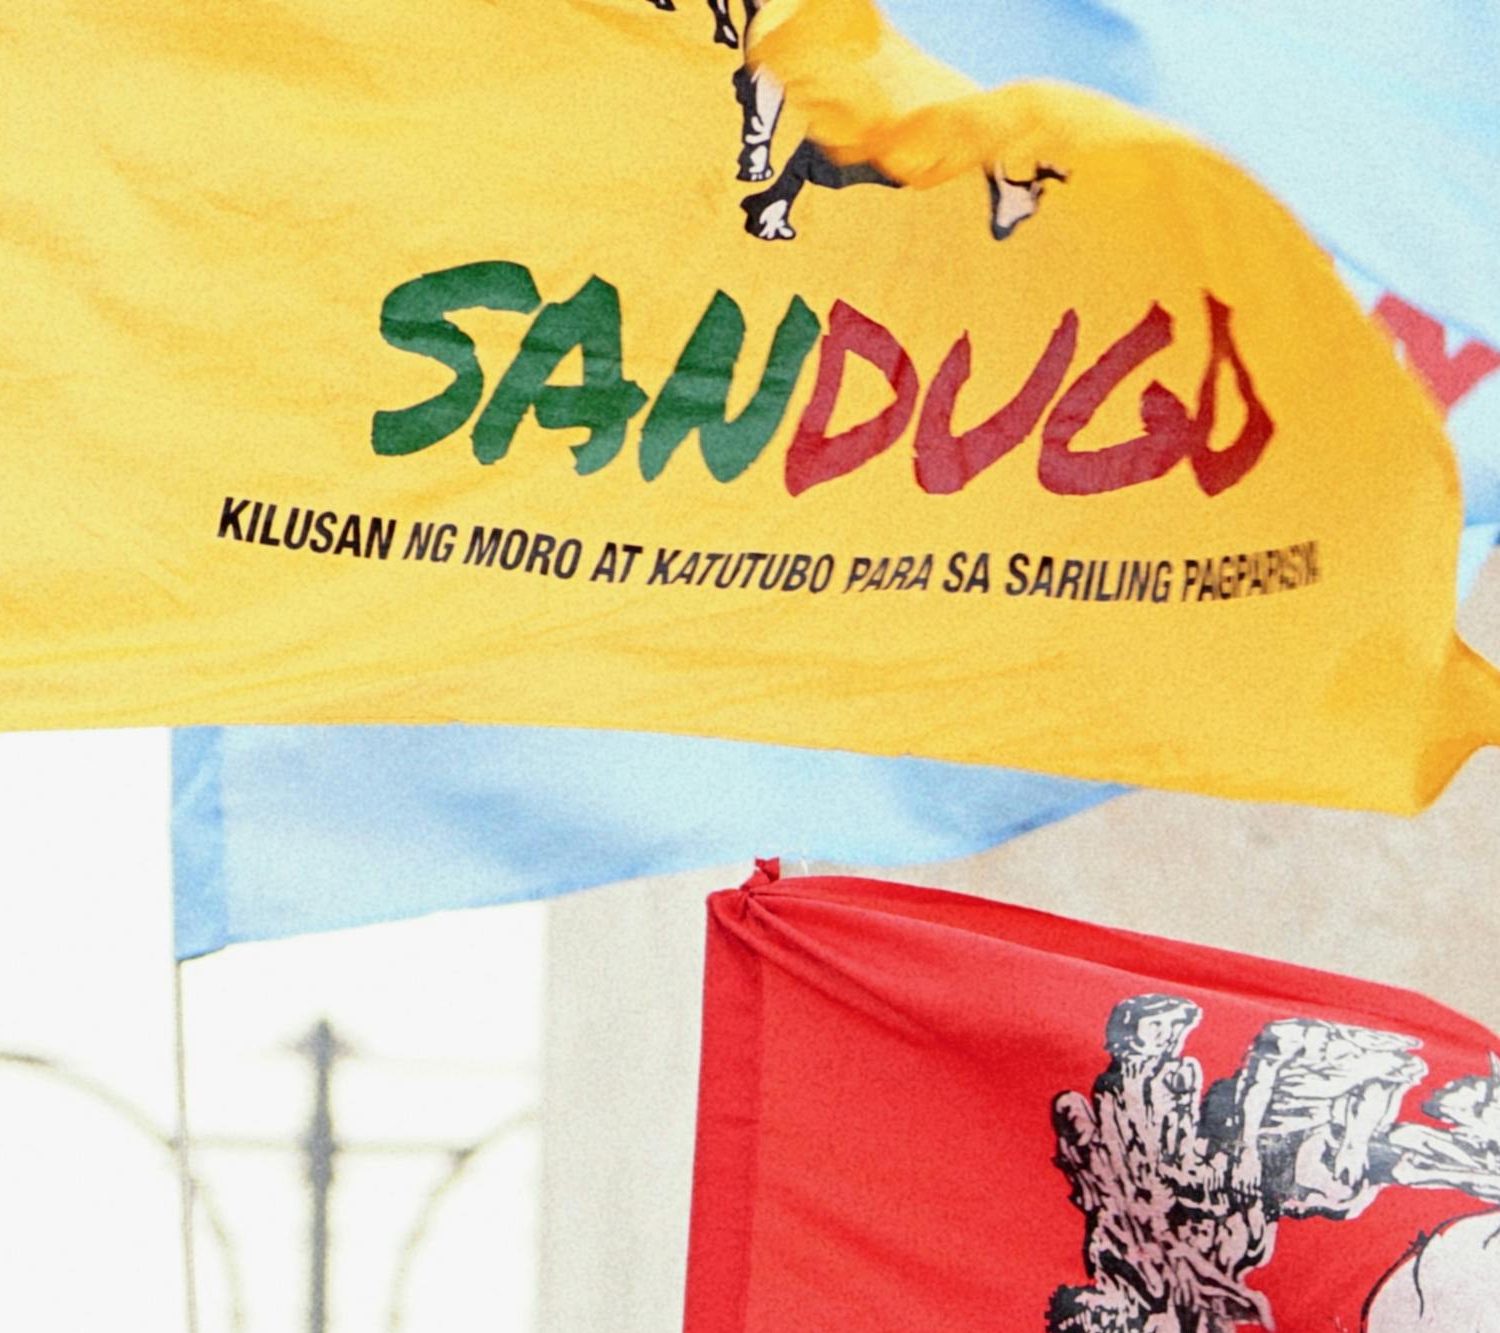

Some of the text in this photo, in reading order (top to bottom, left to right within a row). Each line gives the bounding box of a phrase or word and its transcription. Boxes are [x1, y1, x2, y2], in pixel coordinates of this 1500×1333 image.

[372, 260, 1275, 497] SANDUGO
[217, 497, 396, 560] KILUSAN
[403, 520, 457, 563] NG
[463, 525, 582, 579] MORO
[589, 541, 644, 584] AT
[647, 546, 835, 594] KATUTUBO
[842, 552, 934, 594] PARA
[942, 551, 991, 594] SA
[1004, 552, 1172, 602] SARILING
